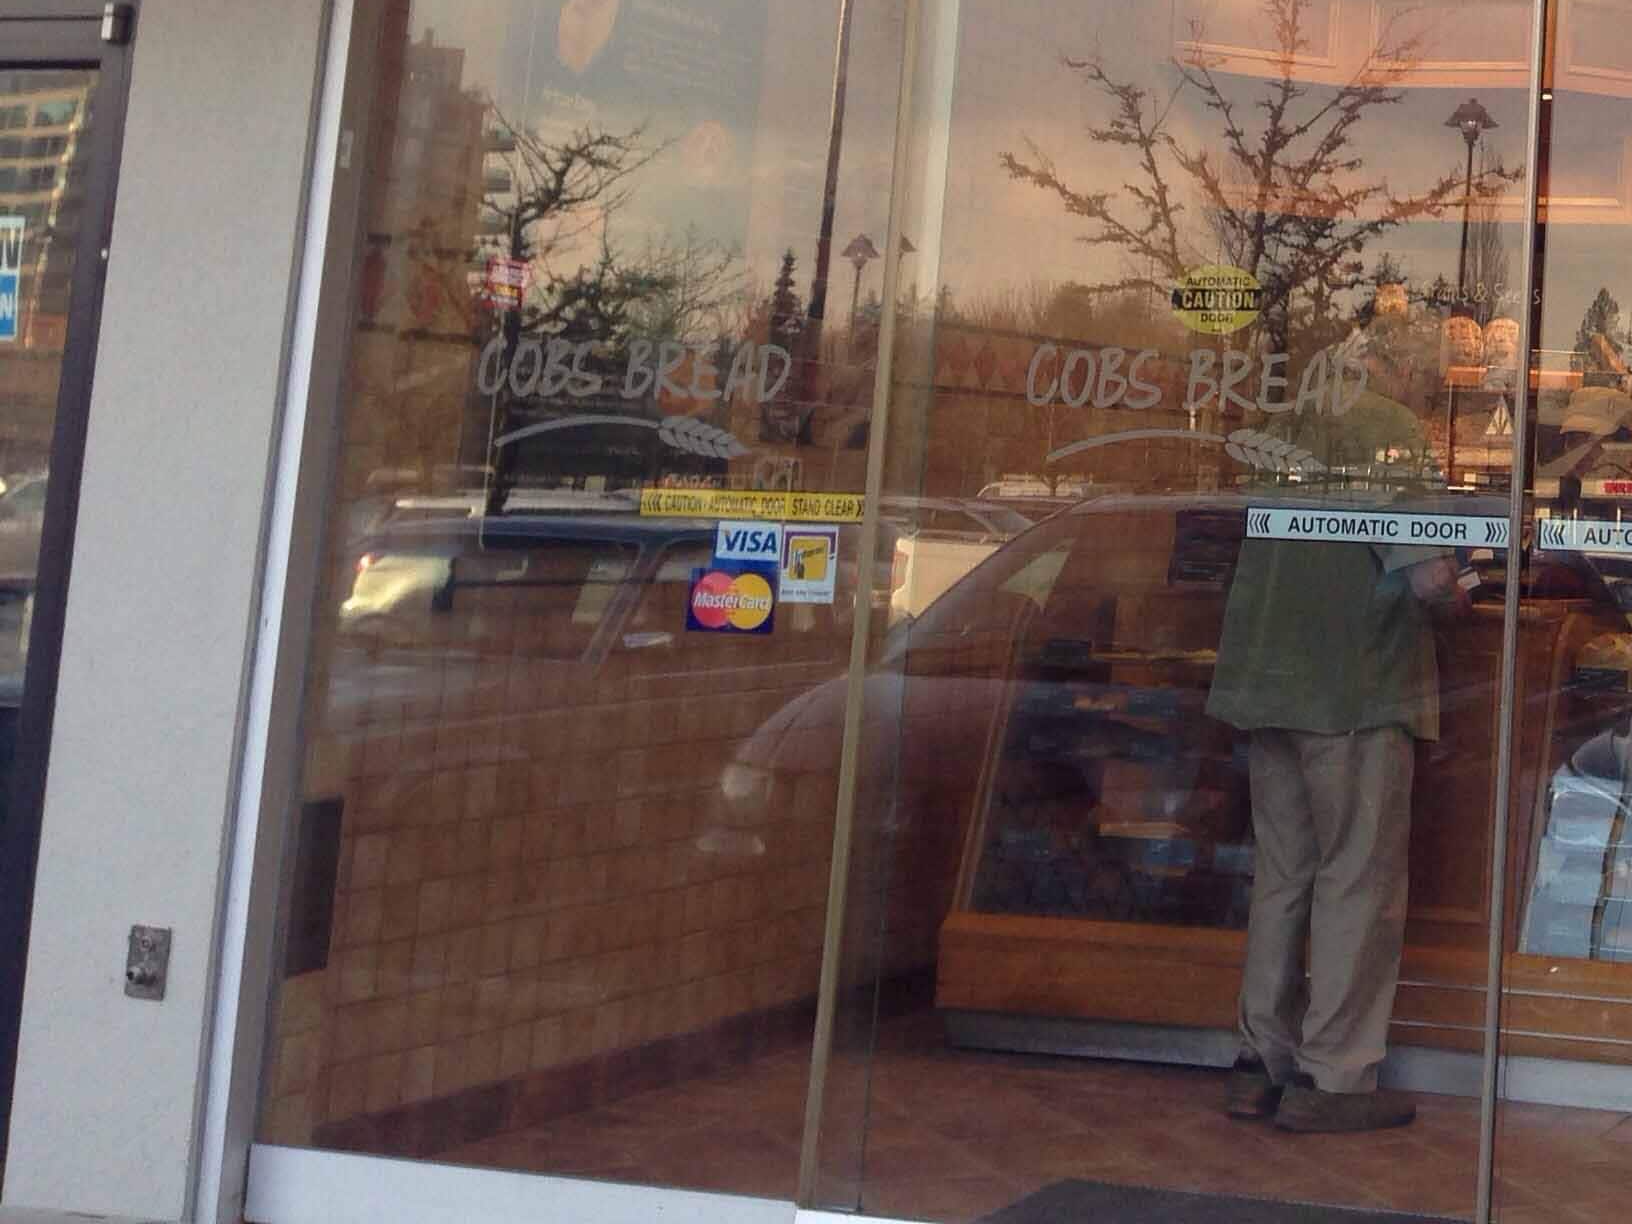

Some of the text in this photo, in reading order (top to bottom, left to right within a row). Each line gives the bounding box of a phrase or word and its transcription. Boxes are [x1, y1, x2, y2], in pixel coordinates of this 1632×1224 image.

[1186, 277, 1250, 287] AUTOMATIC
[1182, 291, 1254, 308] CAUTION
[1201, 313, 1233, 323] DOOR
[478, 334, 792, 403] COBS BREAD
[1026, 341, 1369, 417] COBS BREAD
[792, 498, 821, 516] STAND
[825, 500, 853, 517] CLEAR
[1286, 517, 1467, 541] AUTOMATIC DOOR
[724, 530, 777, 554] VISA
[693, 591, 772, 612] MasterCard
